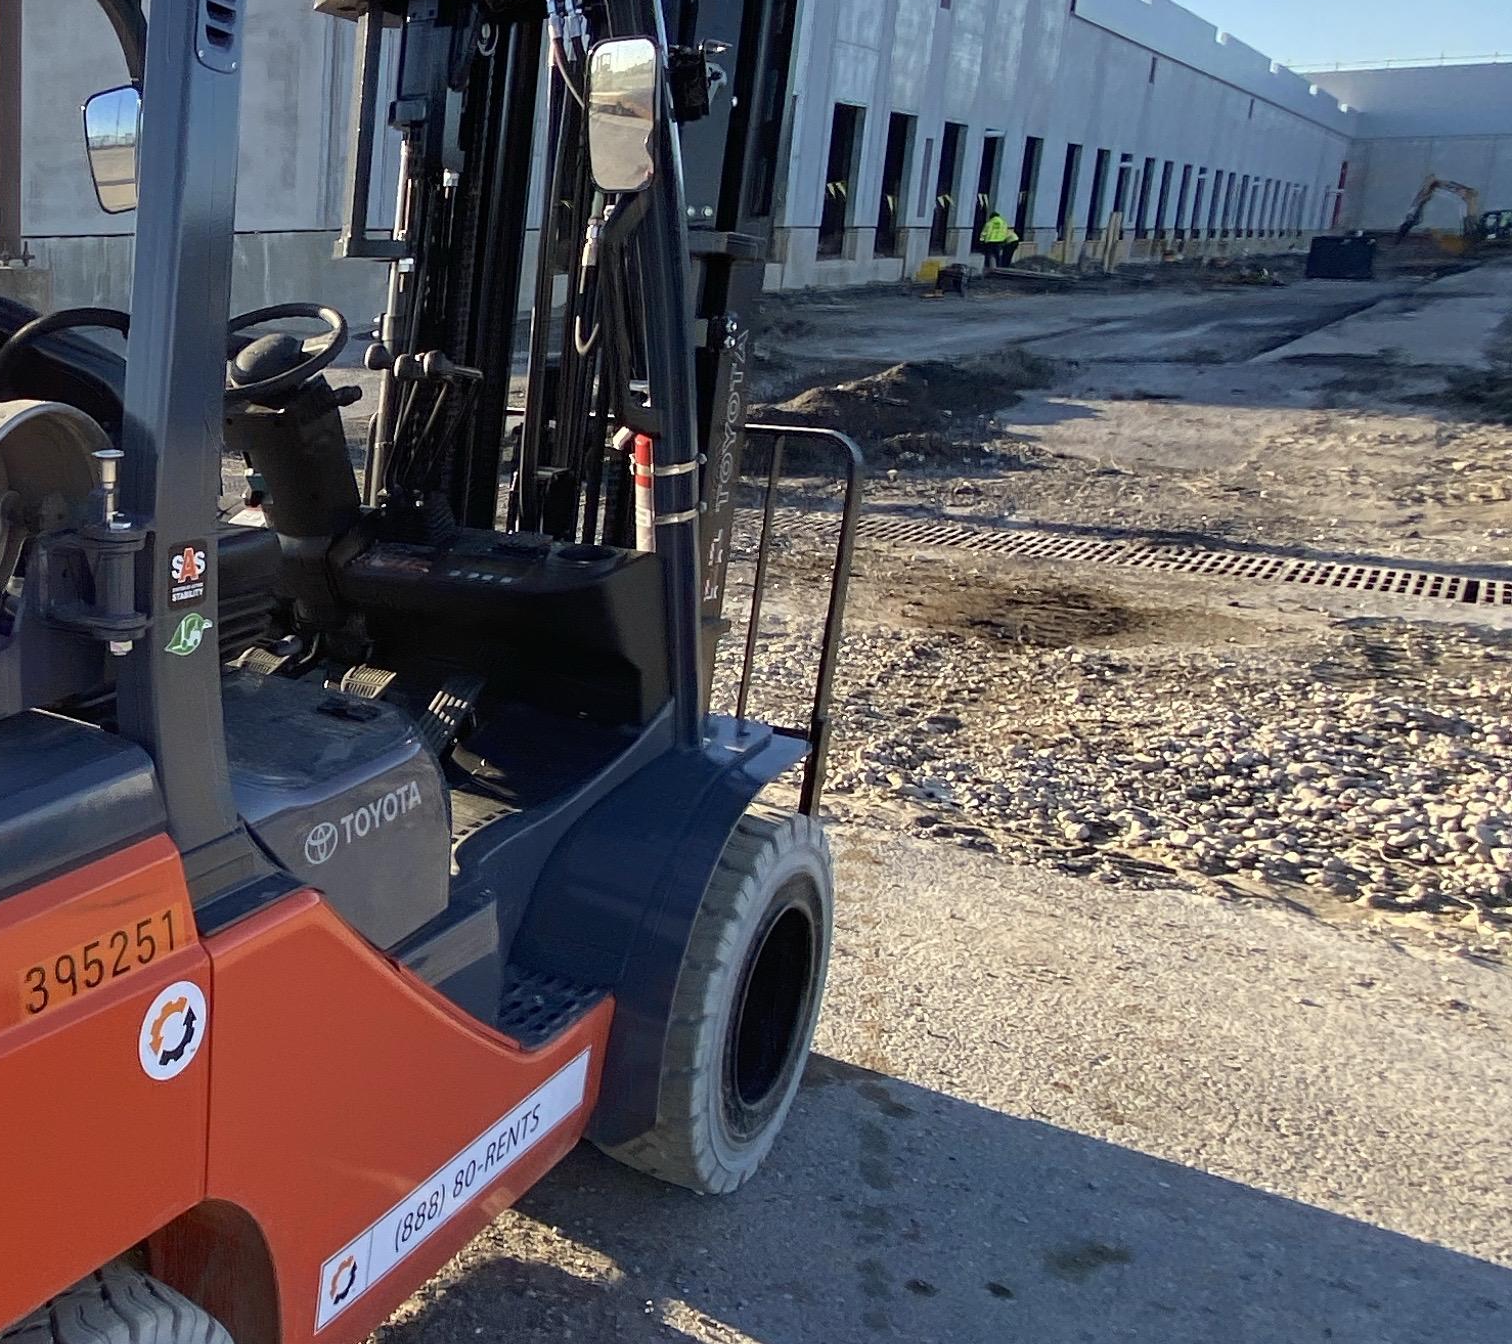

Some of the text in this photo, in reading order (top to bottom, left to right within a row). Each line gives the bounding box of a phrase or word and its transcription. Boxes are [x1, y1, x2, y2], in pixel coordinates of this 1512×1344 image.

[715, 329, 750, 512] TOYOTA
[171, 547, 206, 583] SAS
[340, 780, 422, 844] TOYOTA
[24, 910, 174, 1015] 395251
[394, 1103, 541, 1253] (888) 80-RENTS
